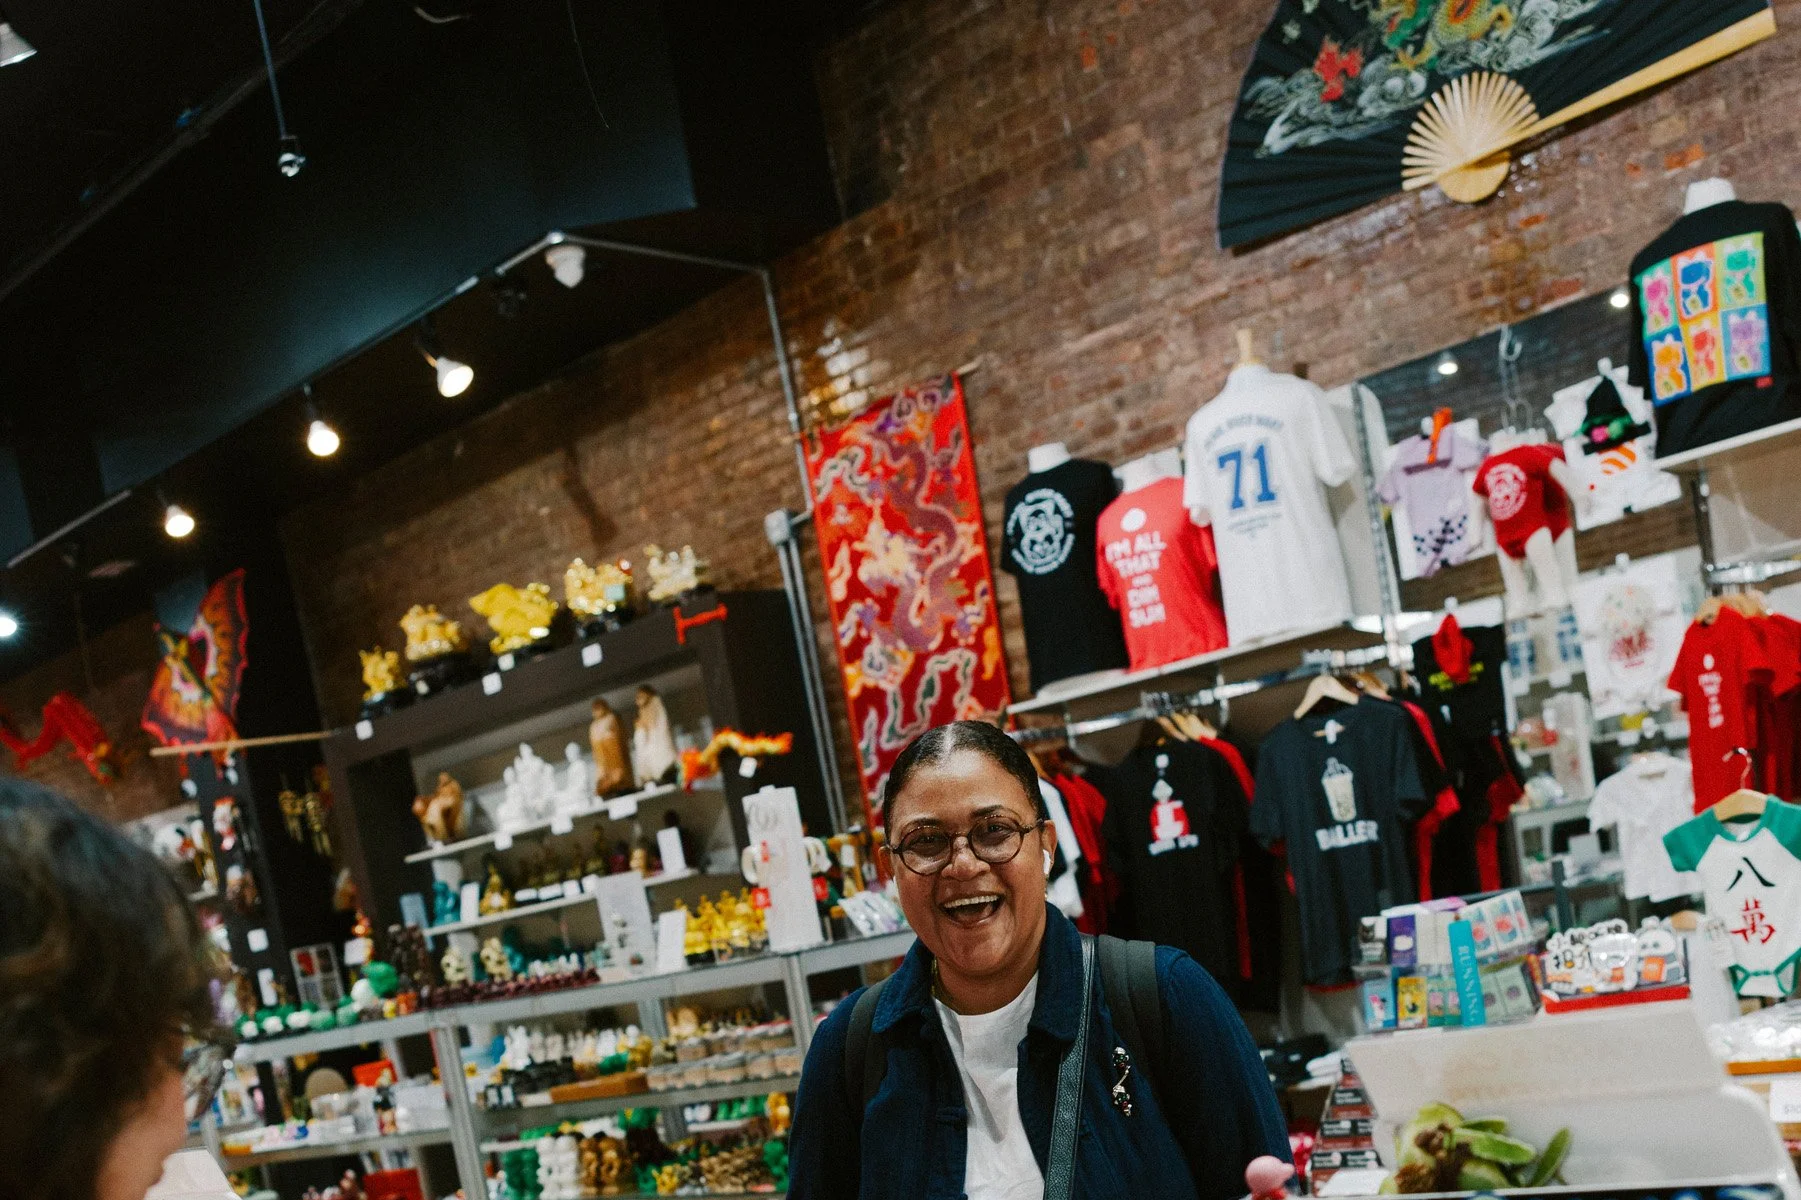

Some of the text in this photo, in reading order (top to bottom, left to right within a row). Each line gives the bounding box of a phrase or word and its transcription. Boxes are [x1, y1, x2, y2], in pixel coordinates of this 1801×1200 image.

[1217, 444, 1277, 510] 71
[1134, 531, 1167, 554] ALL
[1114, 551, 1161, 579] THAT
